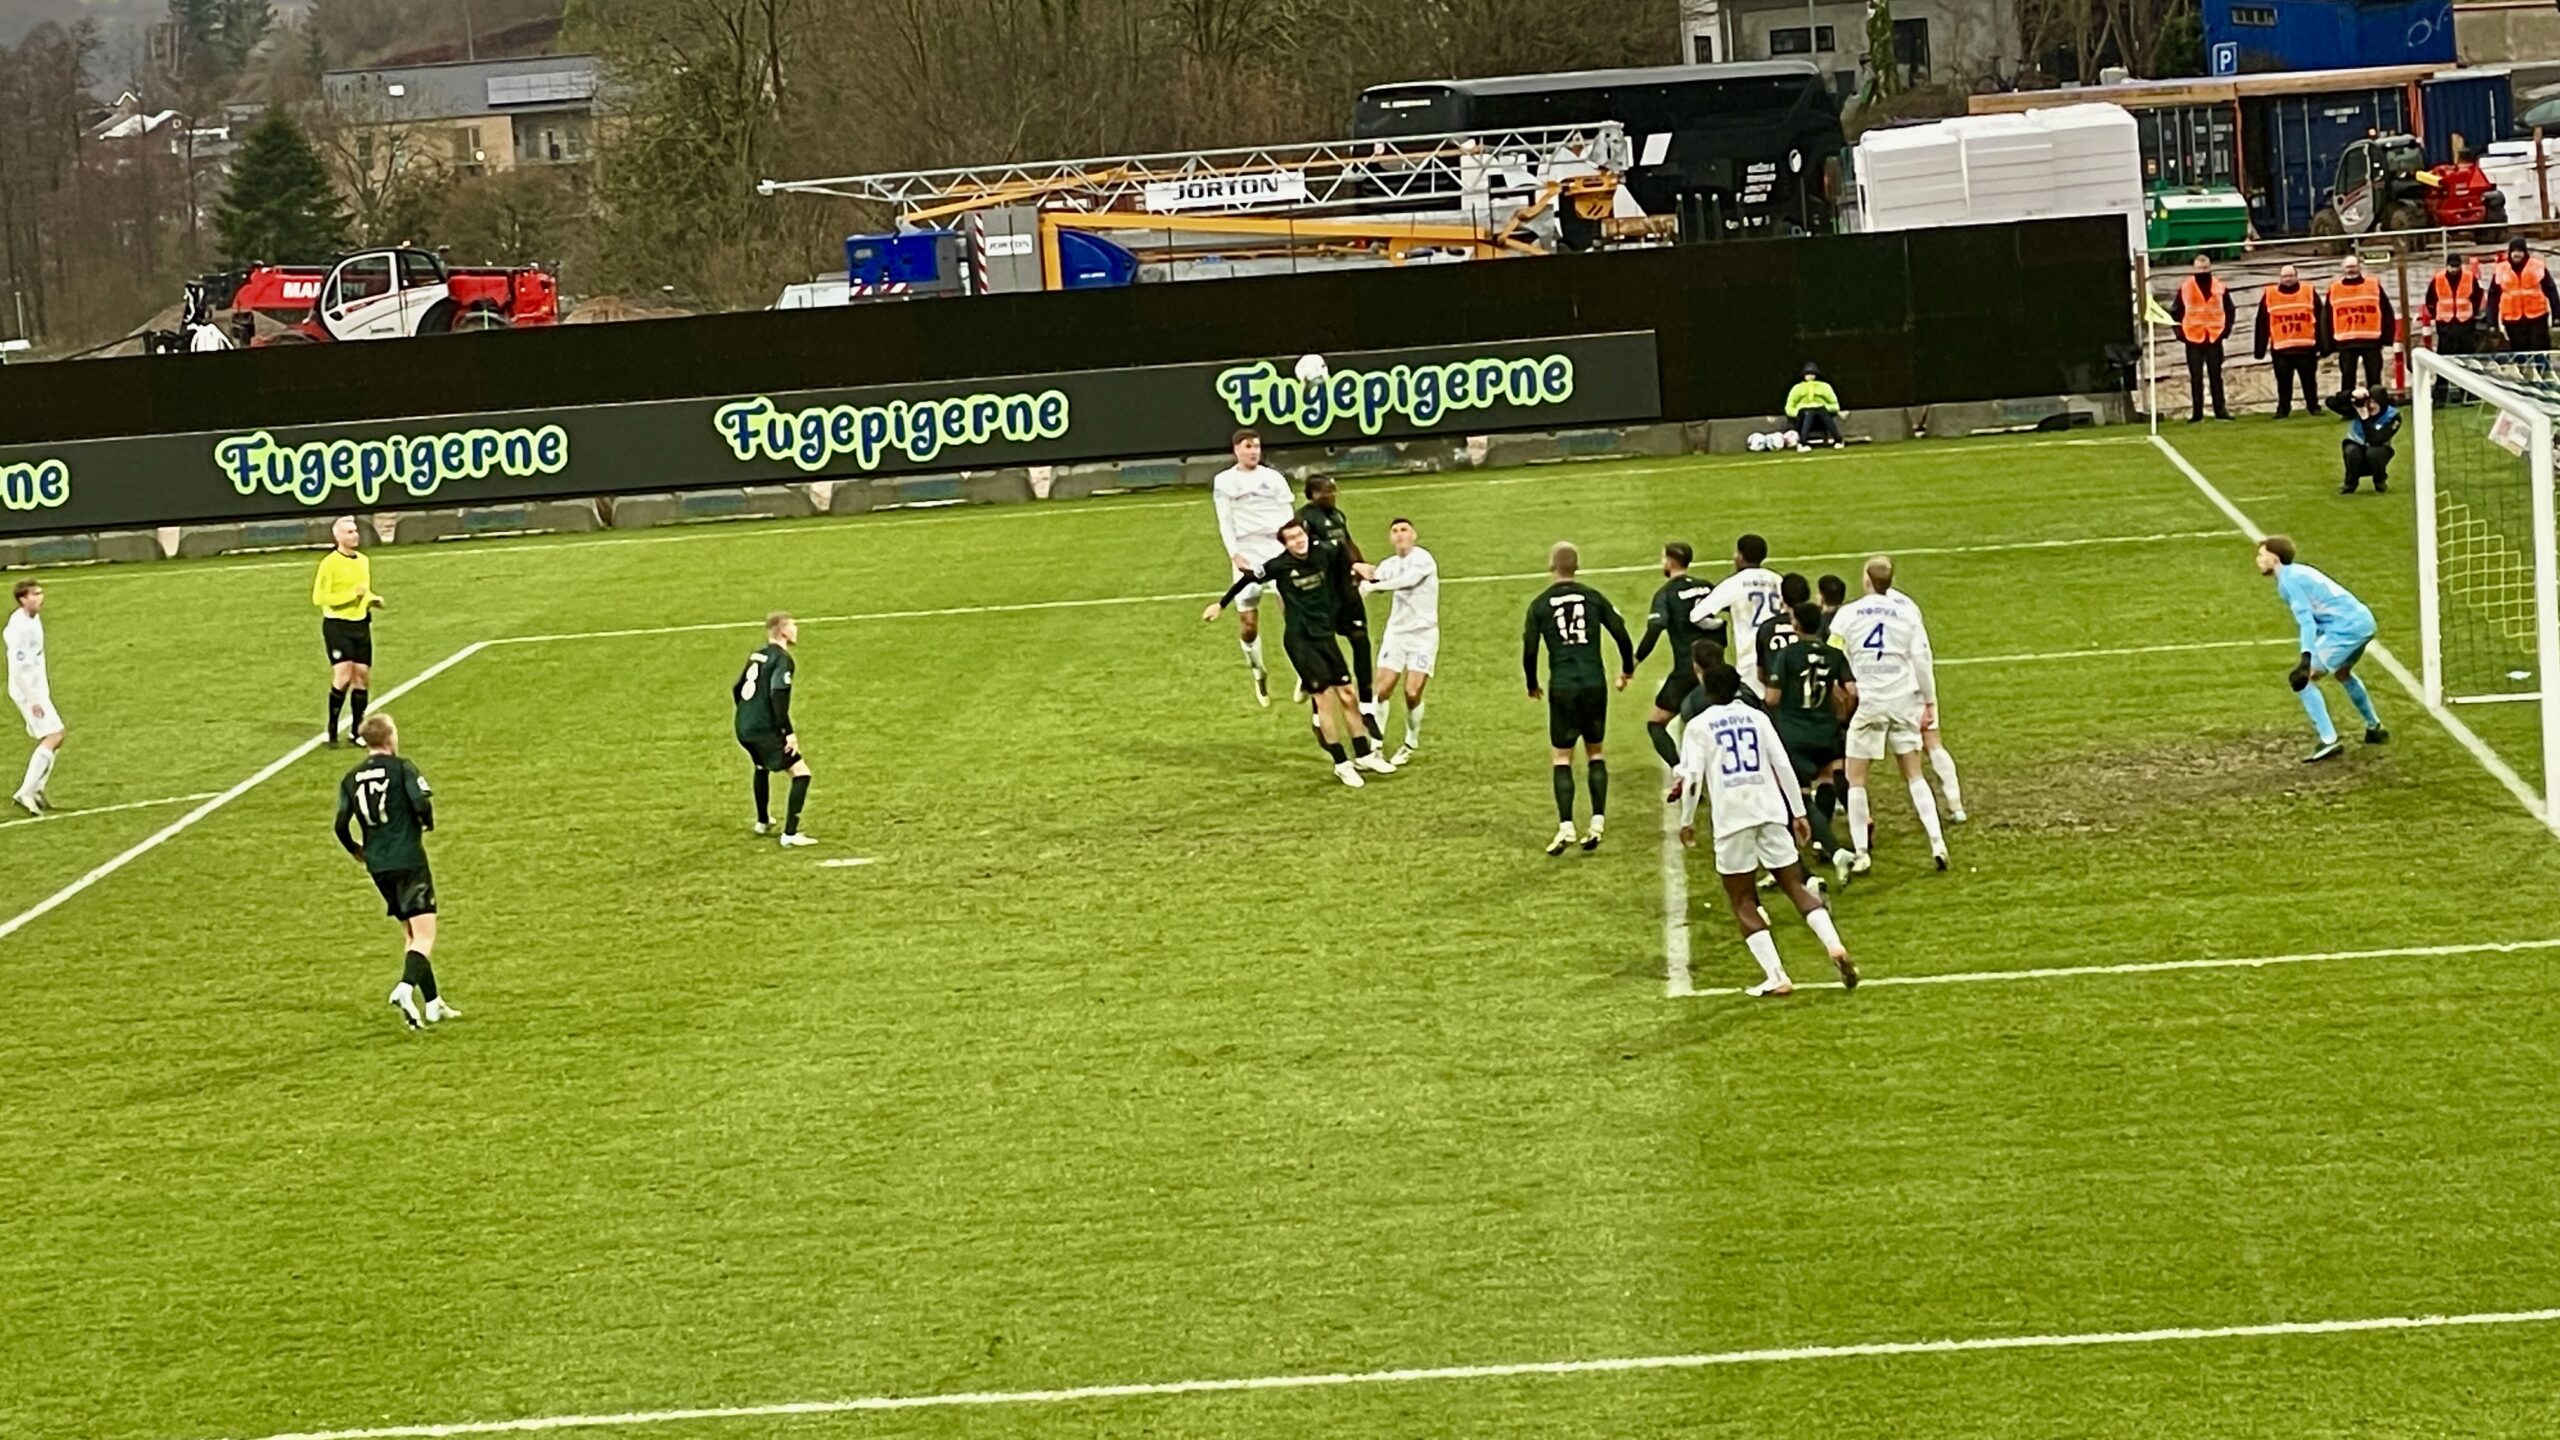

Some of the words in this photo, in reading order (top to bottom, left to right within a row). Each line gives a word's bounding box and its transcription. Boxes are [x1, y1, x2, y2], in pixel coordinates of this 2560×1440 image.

[2219, 50, 2232, 71] P
[1173, 178, 1278, 200] JORTON
[1216, 355, 1573, 434] Fugepigerne
[714, 391, 1069, 470] Fugepigerne
[0, 459, 69, 509] ne
[215, 425, 568, 504] Fugepigerne
[1553, 603, 1588, 645] 14
[1863, 622, 1885, 661] 4
[741, 662, 759, 701] 8
[1800, 666, 1831, 709] 15
[1715, 727, 1760, 775] 33
[355, 778, 391, 826] 17
